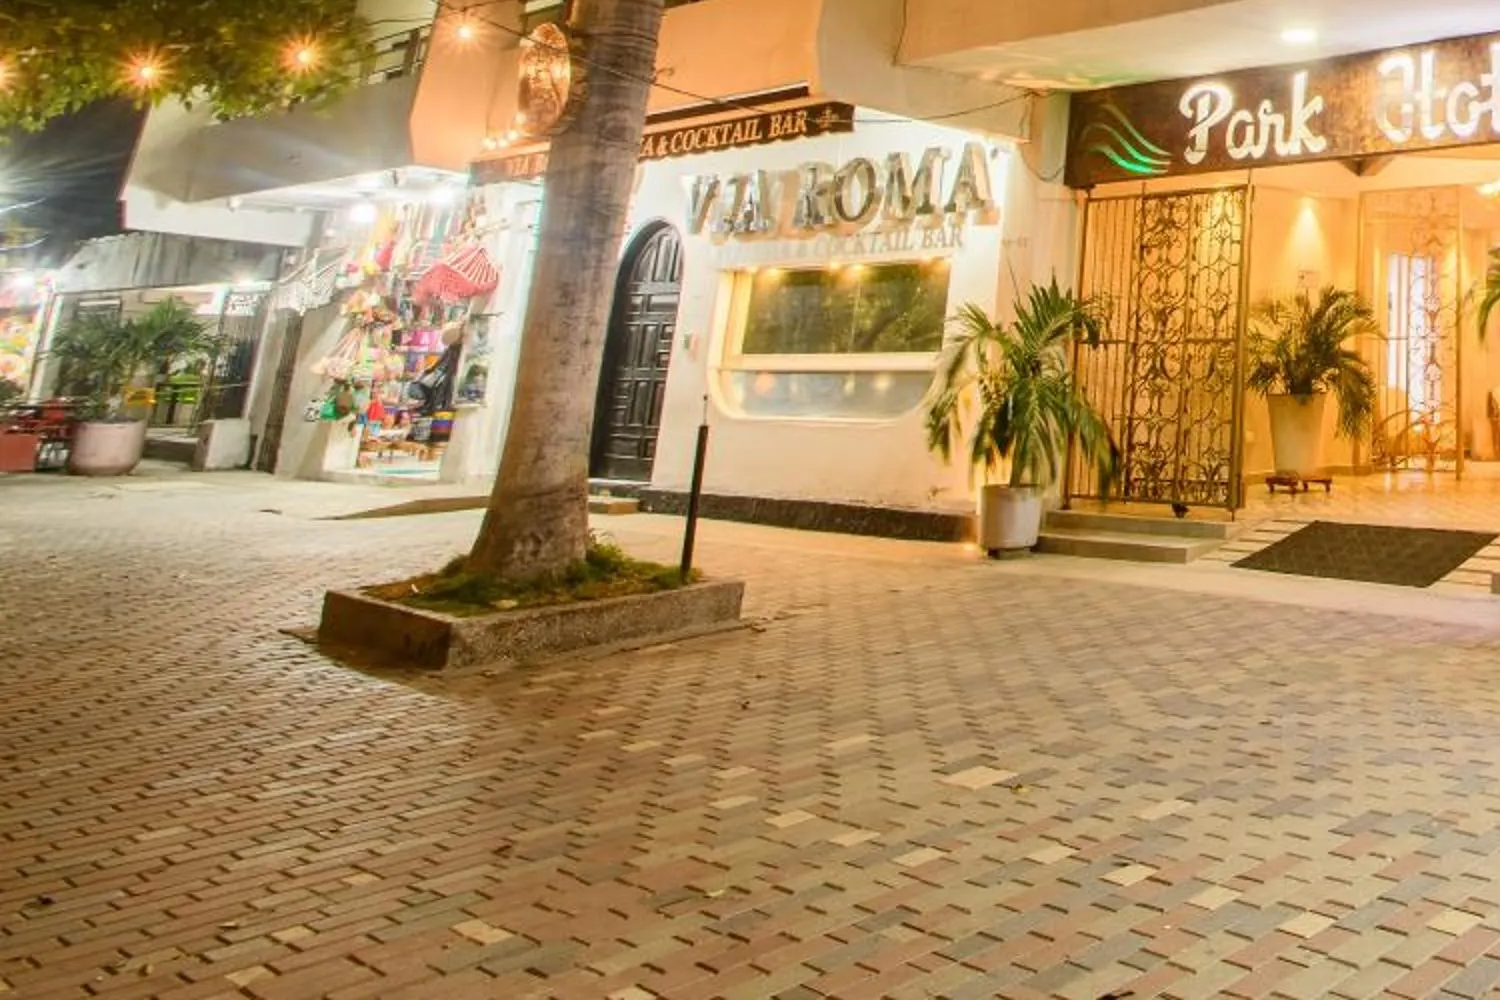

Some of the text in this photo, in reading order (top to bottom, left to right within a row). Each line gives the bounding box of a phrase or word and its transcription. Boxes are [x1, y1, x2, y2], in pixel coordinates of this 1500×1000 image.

[671, 117, 763, 153] COCKTAIL
[767, 111, 809, 137] BAR
[1179, 70, 1327, 165] Park
[683, 142, 992, 235] VIA ROMA
[921, 225, 963, 249] BAR
